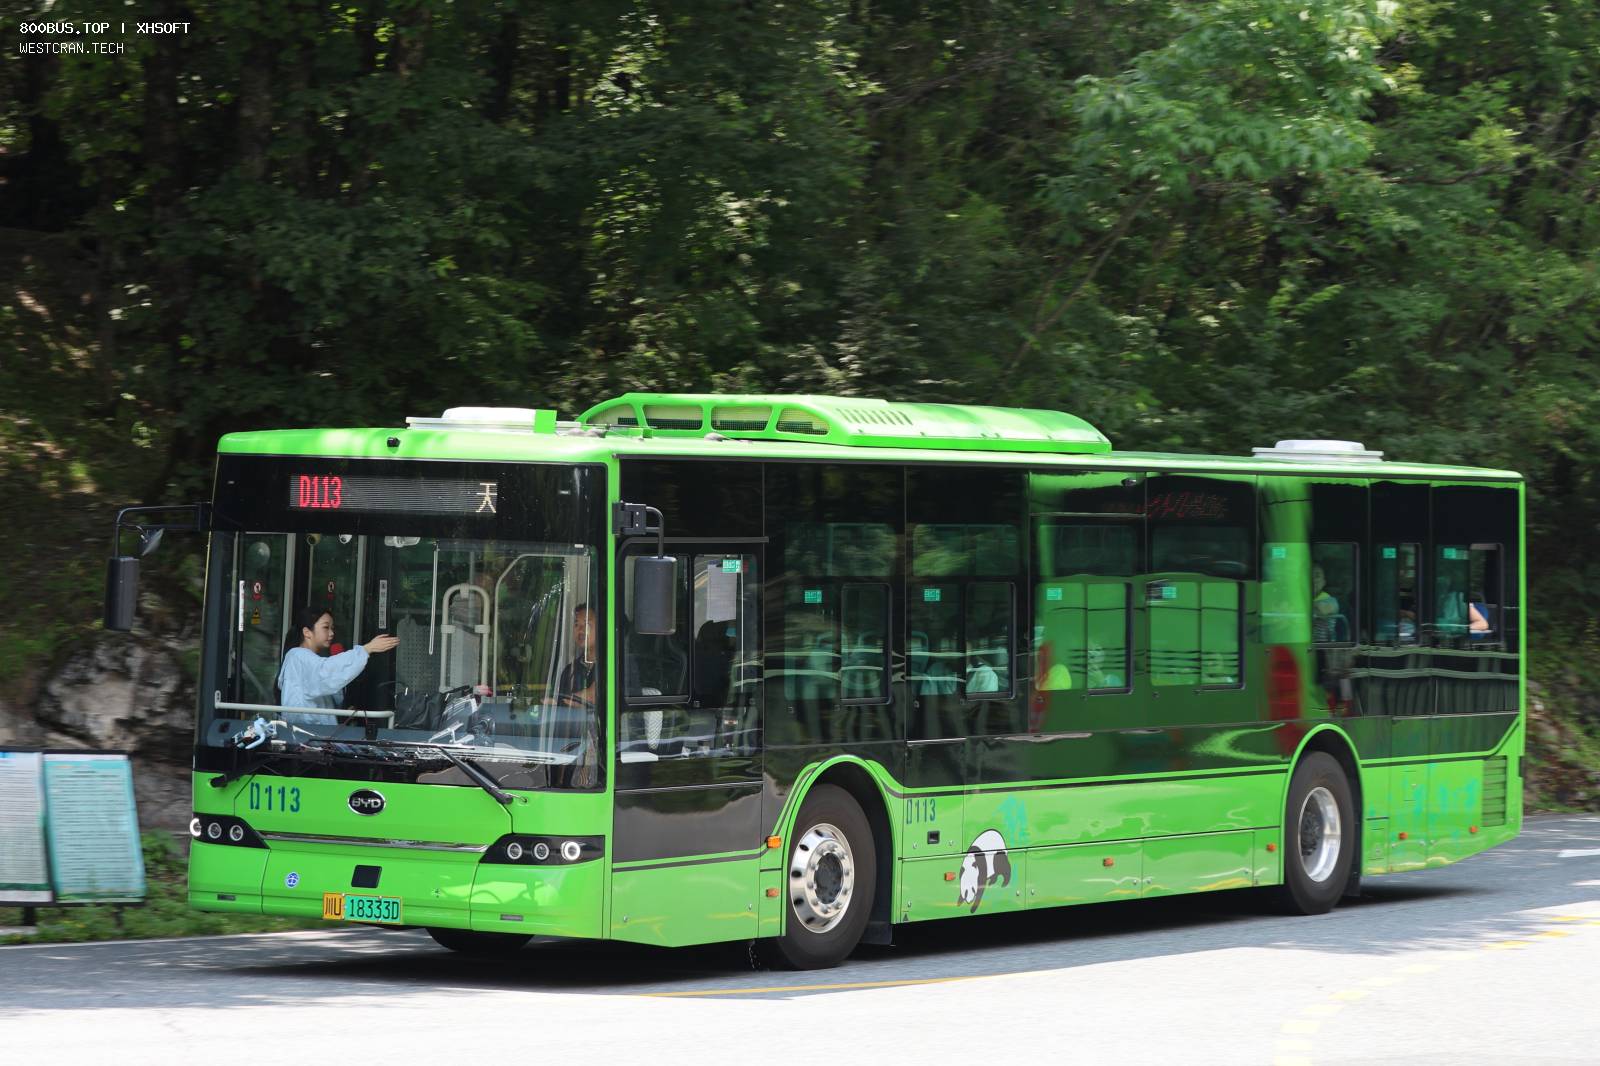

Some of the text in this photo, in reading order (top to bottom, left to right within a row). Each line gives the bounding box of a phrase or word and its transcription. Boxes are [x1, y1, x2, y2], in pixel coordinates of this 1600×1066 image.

[299, 475, 498, 513] D113 天
[250, 783, 301, 813] D113
[352, 797, 382, 808] BYD
[907, 799, 936, 825] D113
